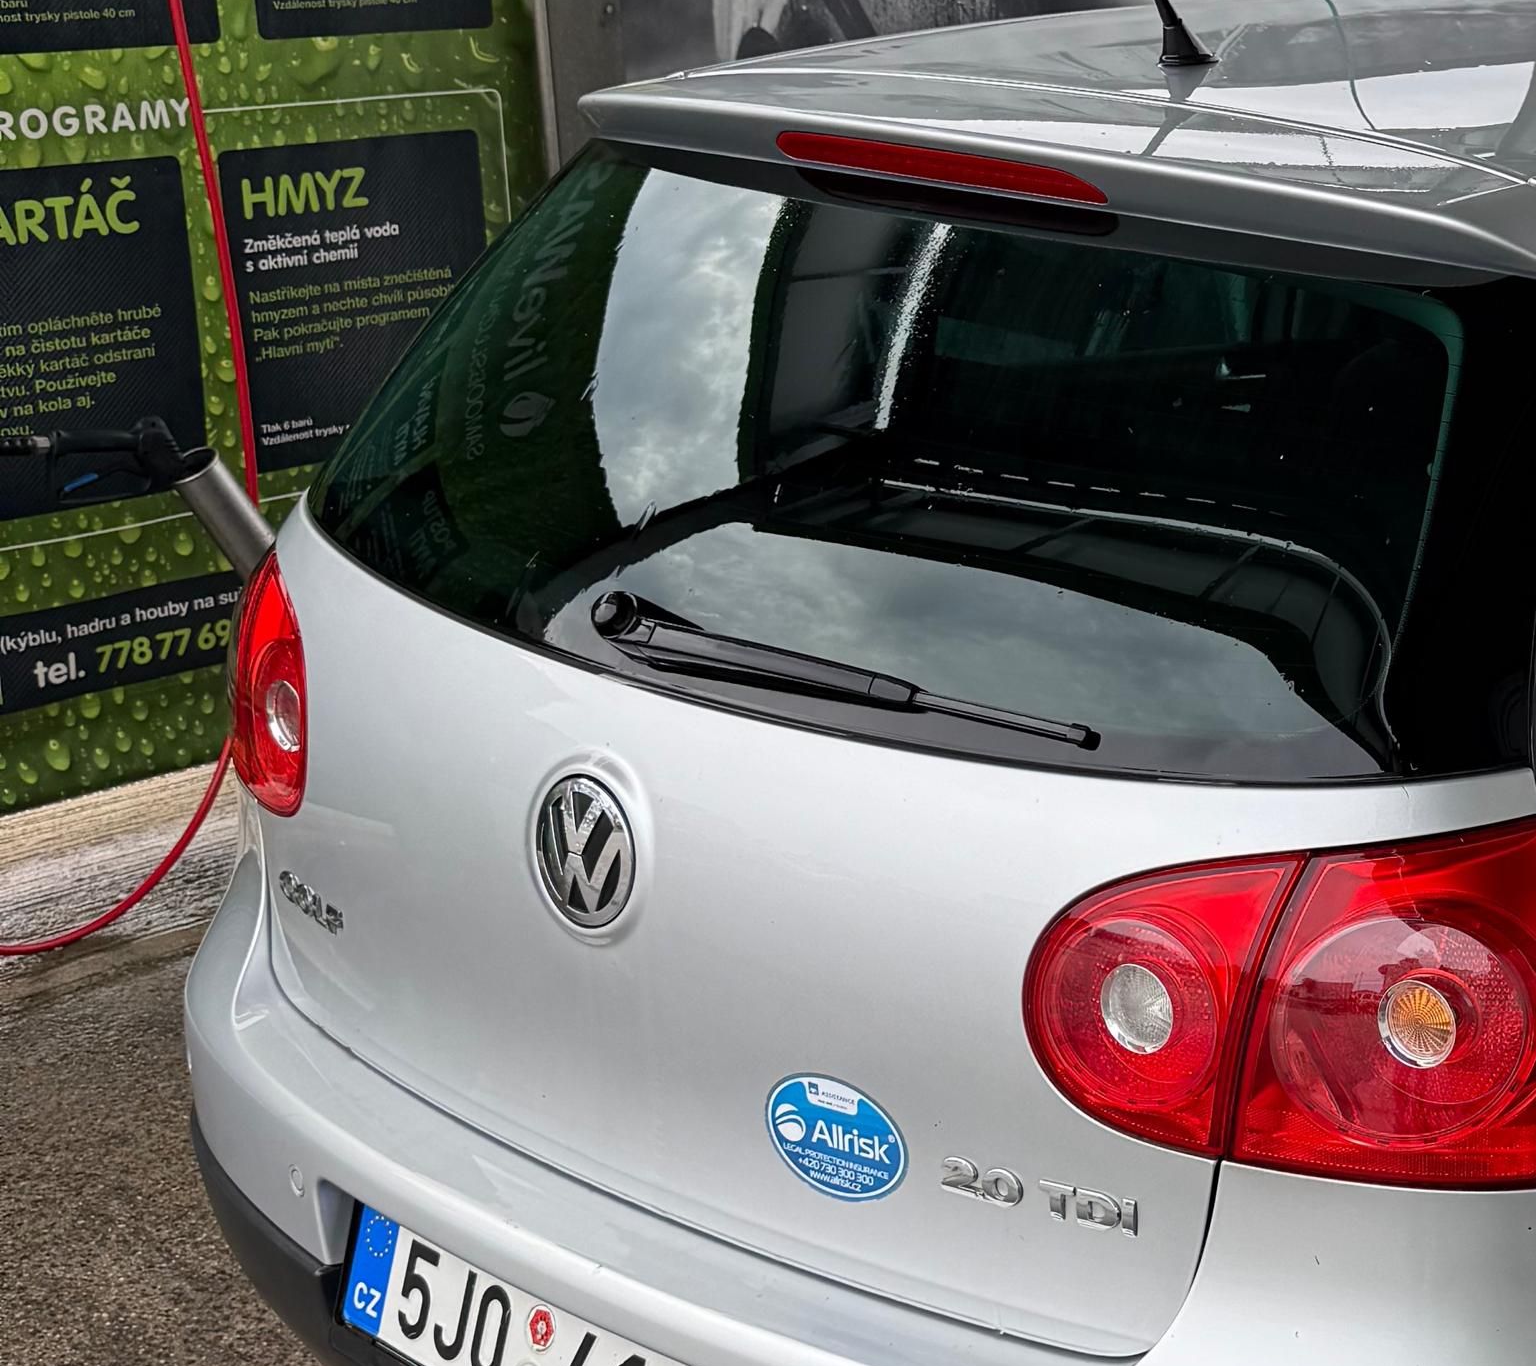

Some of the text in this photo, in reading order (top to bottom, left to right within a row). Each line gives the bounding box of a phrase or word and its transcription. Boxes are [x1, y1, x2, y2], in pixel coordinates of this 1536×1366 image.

[25, 10, 60, 23] trysky
[63, 9, 100, 21] pistole
[103, 8, 116, 18] 40
[119, 10, 136, 18] cm
[241, 166, 369, 220] HMYZ
[244, 221, 399, 254] Změkčená teplá voda
[245, 243, 359, 272] s aktivní chemií
[249, 266, 452, 304] Nastříkejte na místa znečištěná
[28, 311, 113, 335] opláchněte
[118, 303, 161, 322] hrubé
[251, 304, 309, 324] hmyzem
[312, 306, 320, 315] a
[323, 293, 369, 312] nechte
[372, 288, 404, 304] chvíli
[253, 307, 430, 342] Pak pokračujte programem
[5, 326, 152, 357] na čistotu kartáče
[40, 354, 90, 373] kartáč
[94, 343, 156, 364] odstraní
[35, 371, 117, 393] Používejte
[13, 392, 95, 417] na kola aj.
[261, 416, 313, 434] Tlak 6 barů
[262, 431, 314, 447] Vzdálenost
[315, 424, 344, 439] trysky
[0, 586, 242, 655] (kýblu, hadru a houby na su
[33, 652, 86, 688] tel.
[96, 636, 153, 674] 778
[156, 627, 192, 660] 77
[811, 1119, 891, 1164] Allrisk
[799, 1158, 874, 1186] +420 730 300 300
[805, 1149, 846, 1168] PROTECTION
[941, 1156, 1140, 1237] 2.0 TDI
[354, 1281, 382, 1319] CZ
